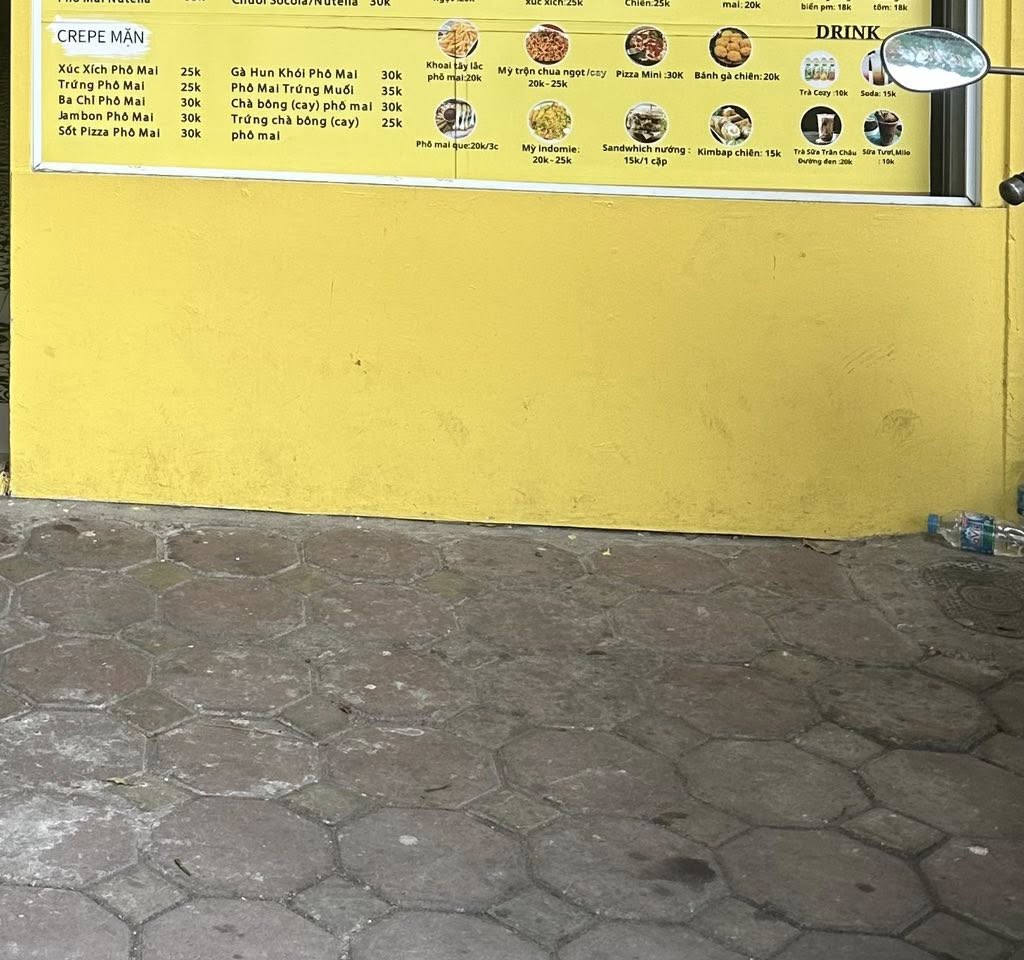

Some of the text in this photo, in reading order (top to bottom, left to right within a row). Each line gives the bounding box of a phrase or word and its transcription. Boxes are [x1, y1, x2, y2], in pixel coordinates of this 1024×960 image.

[57, 27, 144, 47] CREPE MẶN
[815, 24, 882, 41] DRINK
[58, 63, 159, 76] Xúc Xích Phô Mai
[180, 66, 201, 77] 25k
[230, 66, 358, 80] Gà Hun Khói Phô Mai
[381, 69, 403, 81] 30k
[57, 79, 145, 92] Trứng Phô Mai
[180, 81, 202, 93] 25k
[231, 82, 254, 93] Phô
[257, 82, 280, 94] Mai
[282, 83, 320, 97] Trứng
[381, 85, 403, 97] 35k
[58, 94, 73, 105] Ba
[98, 95, 121, 106] Phô
[123, 95, 146, 107] Mai
[180, 97, 202, 108] 30k
[230, 97, 373, 113] Chà bông (cay) phô mai
[381, 101, 403, 113] 30k
[57, 110, 154, 122] Jambon Phô Mai
[180, 112, 202, 123] 30k
[230, 113, 360, 129] Trứng chà bông (cay)
[381, 117, 403, 128] 25k
[58, 124, 160, 138] Sốt Pizza Phô Mai
[180, 127, 202, 139] 30k
[231, 129, 280, 142] phô mai
